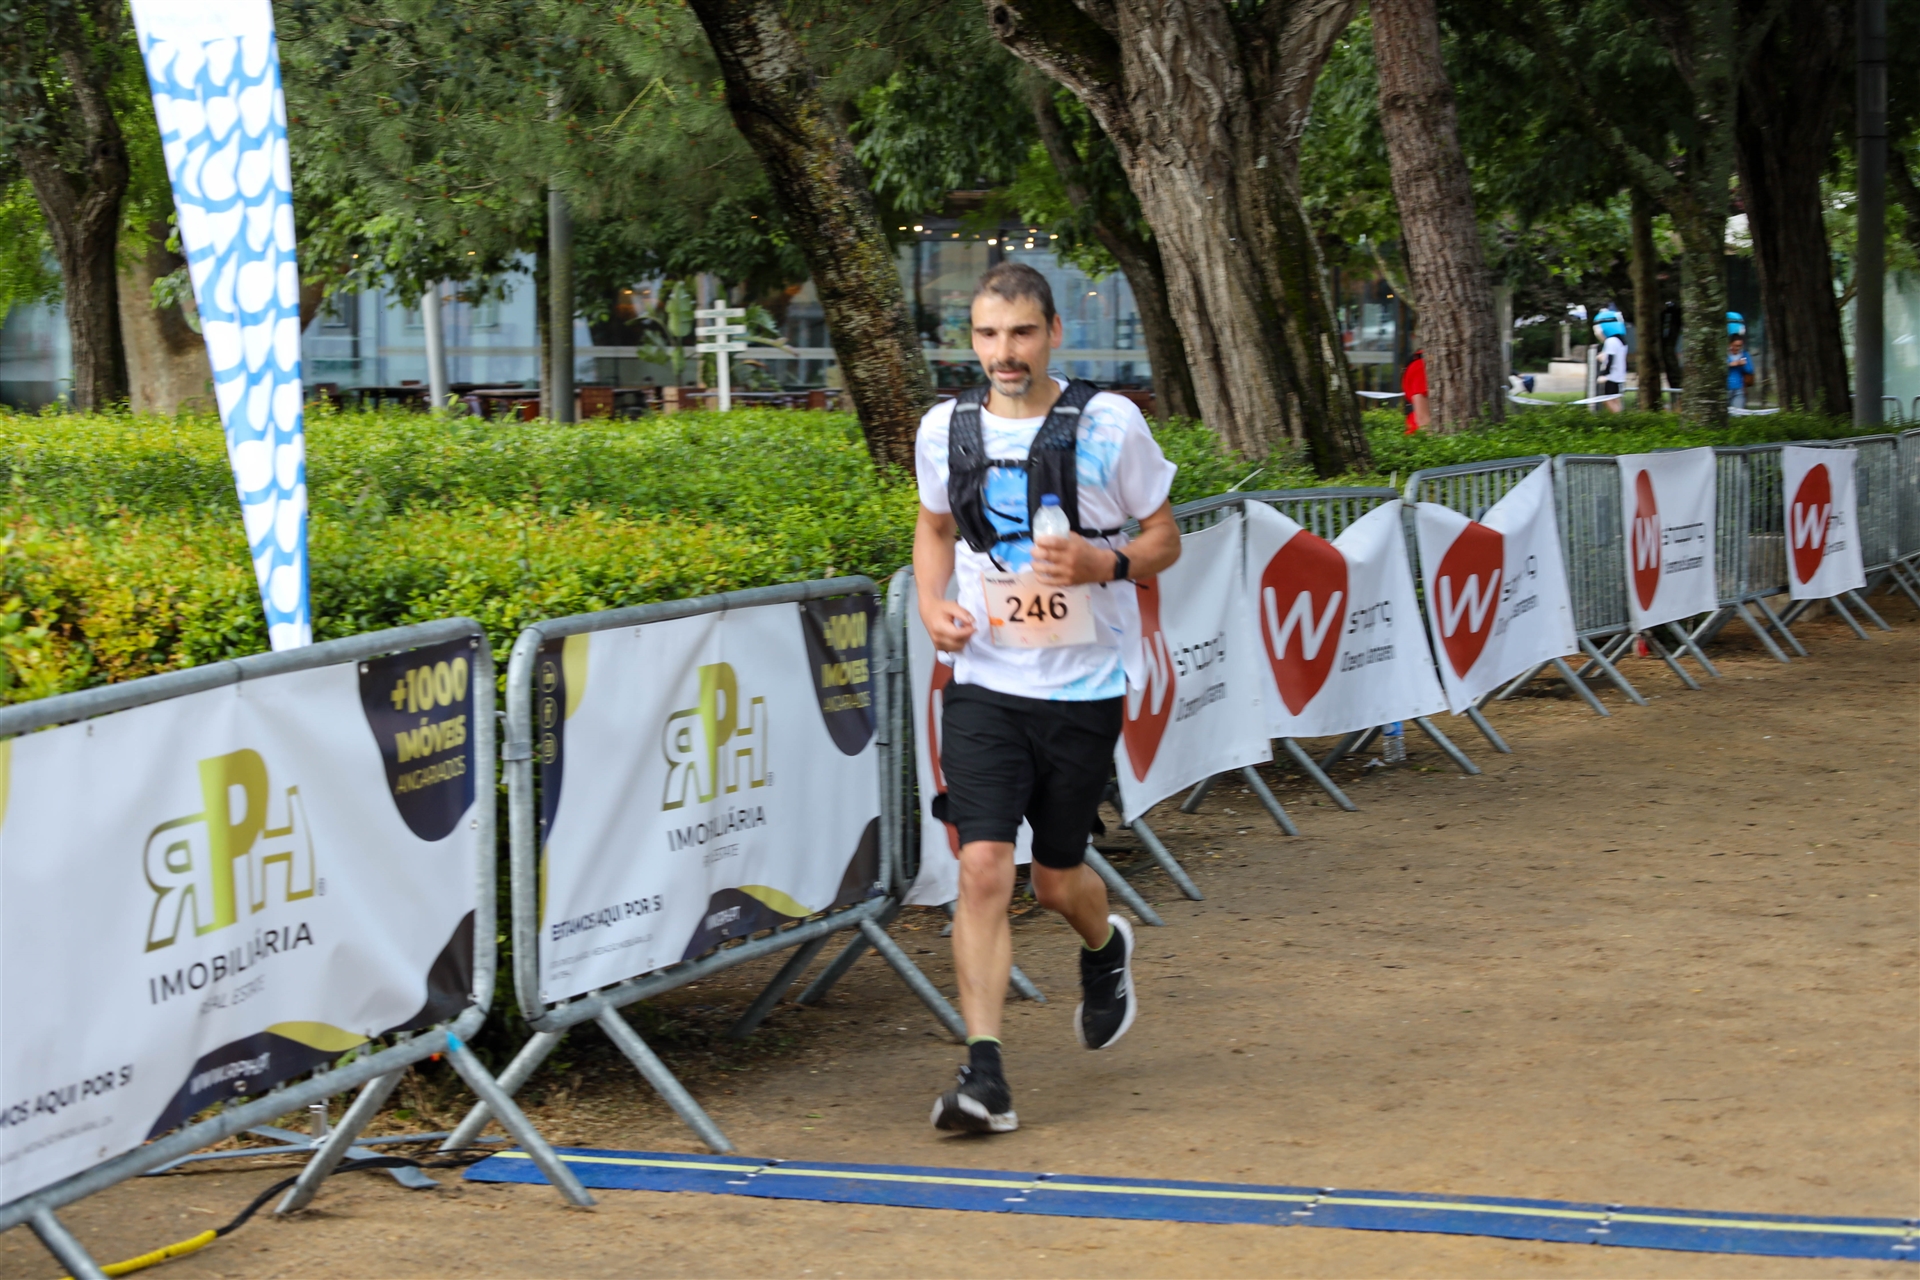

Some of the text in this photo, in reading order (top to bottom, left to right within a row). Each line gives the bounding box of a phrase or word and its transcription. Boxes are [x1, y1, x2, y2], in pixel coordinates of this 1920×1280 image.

[1006, 592, 1068, 622] 246
[1263, 586, 1343, 660] W
[1439, 568, 1500, 637] W
[390, 657, 468, 713] +1000
[394, 714, 467, 763] IMÓVEIS
[149, 921, 314, 1005] IMOBILIÁRIA
[33, 1083, 78, 1115] AQUI
[81, 1071, 115, 1101] POR
